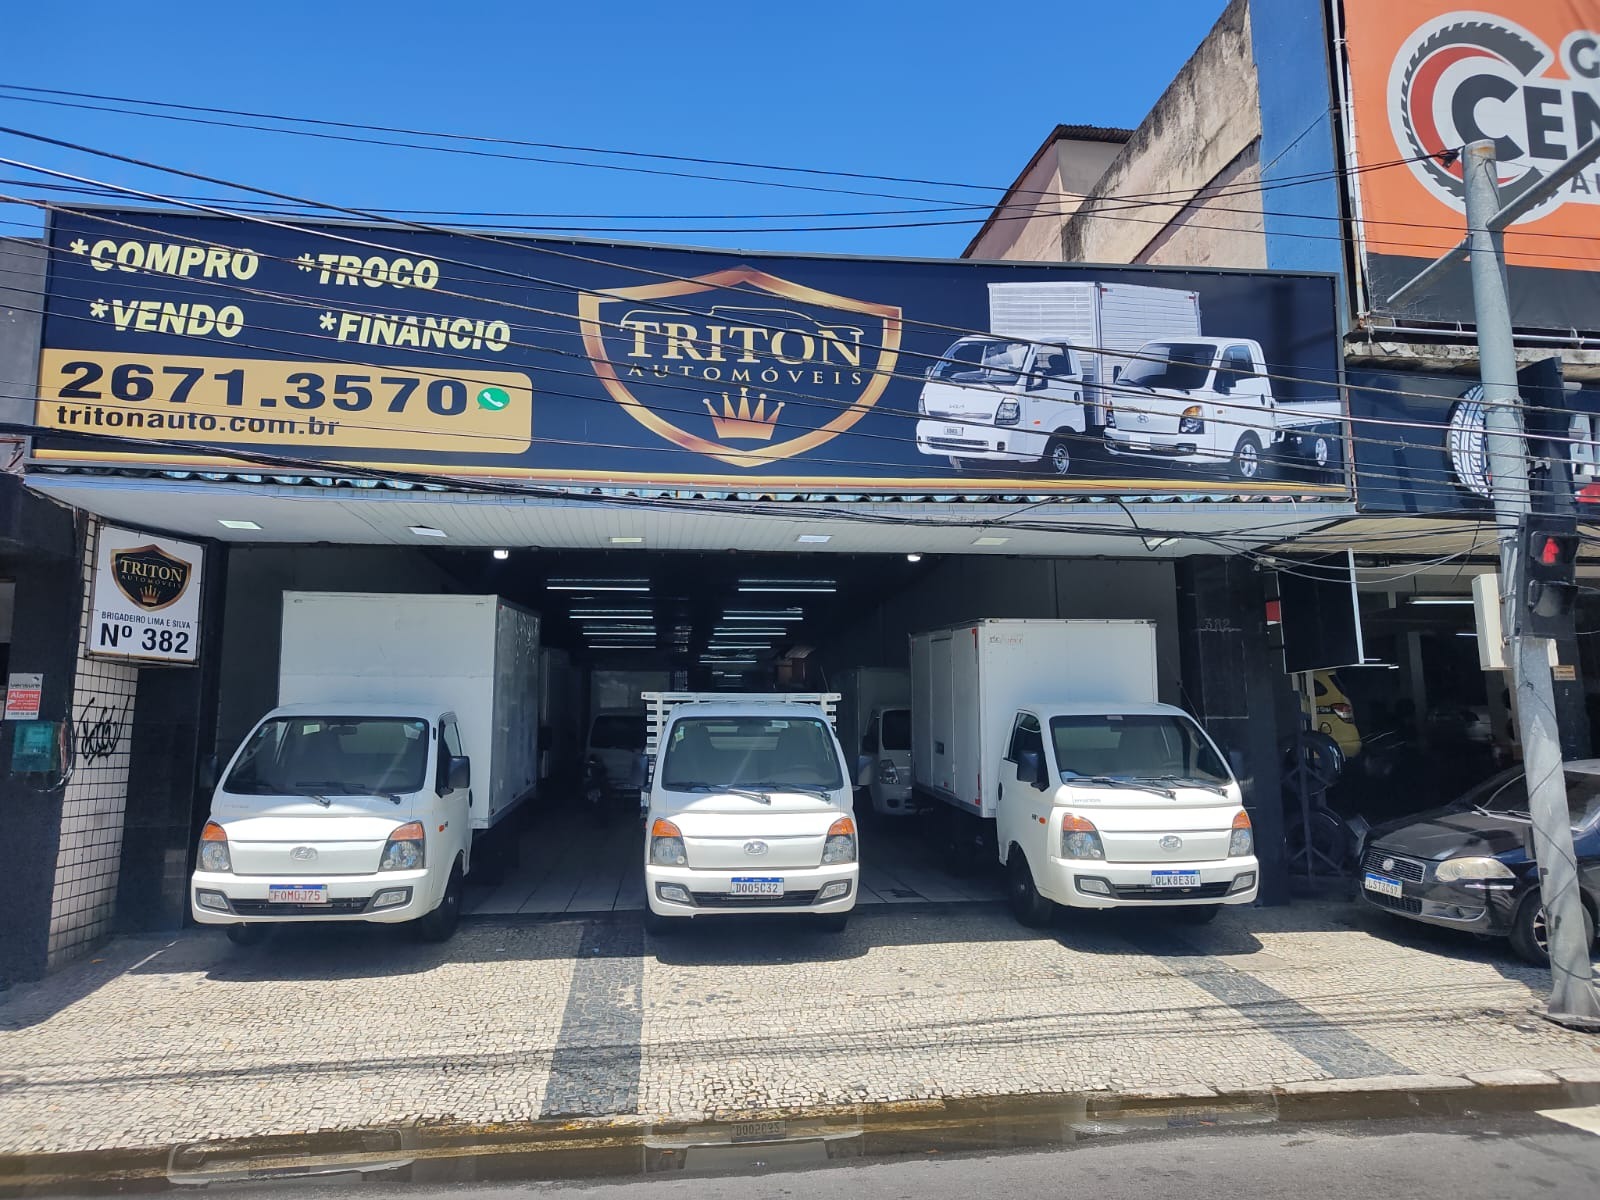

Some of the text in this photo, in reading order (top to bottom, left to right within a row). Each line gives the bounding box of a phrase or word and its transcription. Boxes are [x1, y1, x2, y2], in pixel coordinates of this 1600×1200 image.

[622, 319, 864, 367] TRITON
[628, 363, 863, 385] AUTOMÓVEIS
[58, 361, 468, 416] 2671.3570
[57, 404, 340, 437] tritonauto.com.br
[120, 558, 183, 583] TRITON
[101, 611, 191, 629] BRIGADEIRO LIMA E SILVA
[141, 628, 189, 654] 382
